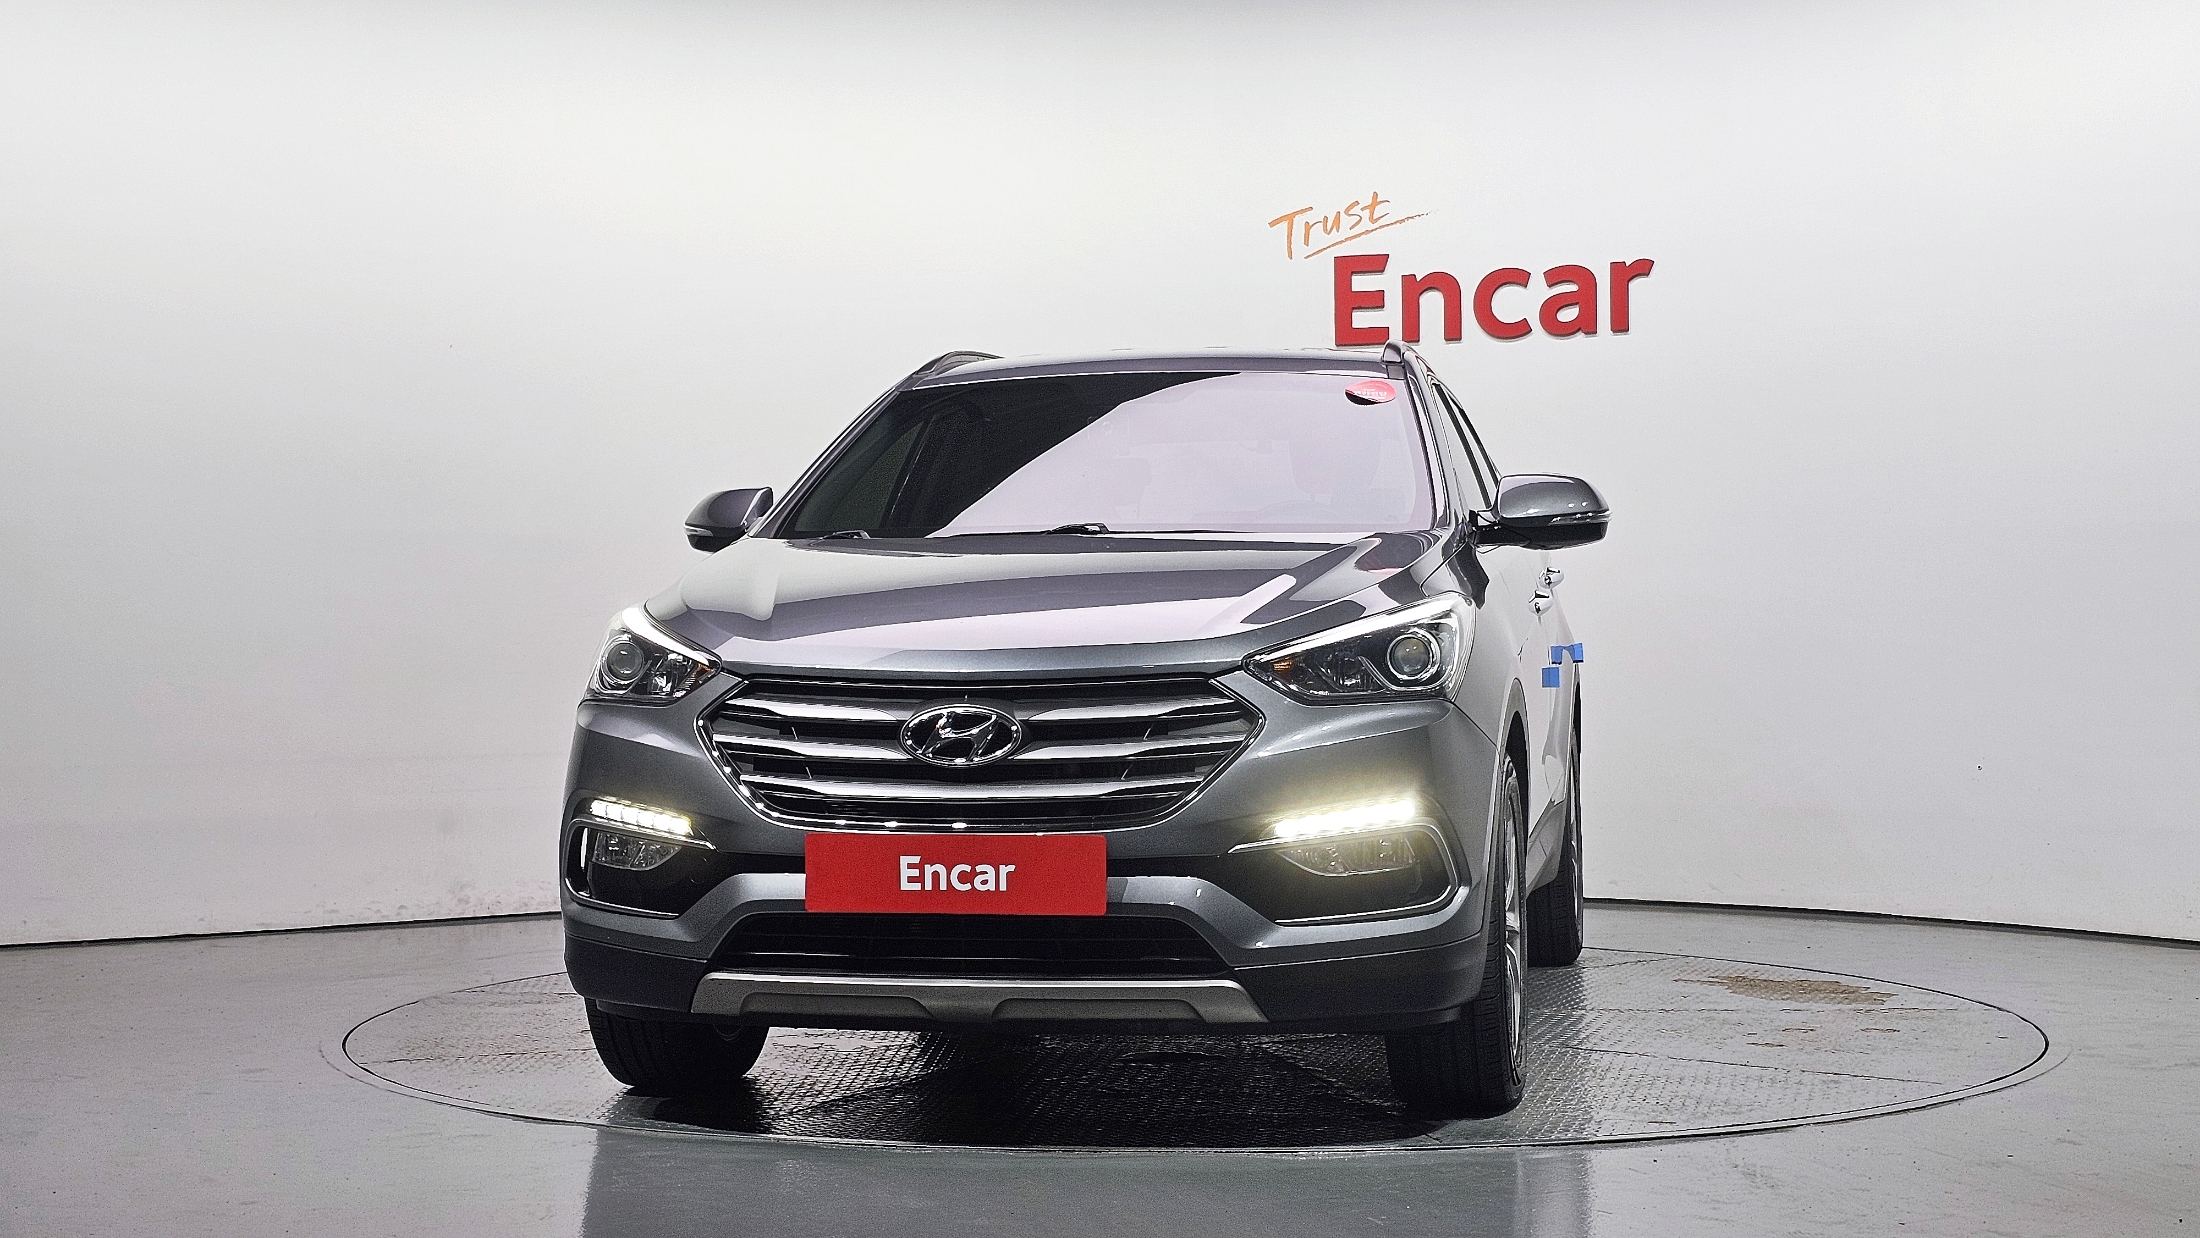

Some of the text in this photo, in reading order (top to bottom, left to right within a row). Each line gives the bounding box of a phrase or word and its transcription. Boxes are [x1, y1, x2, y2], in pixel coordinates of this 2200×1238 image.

[1268, 191, 1390, 260] Trust
[1334, 254, 1655, 346] Encar
[900, 856, 1015, 891] Encar
